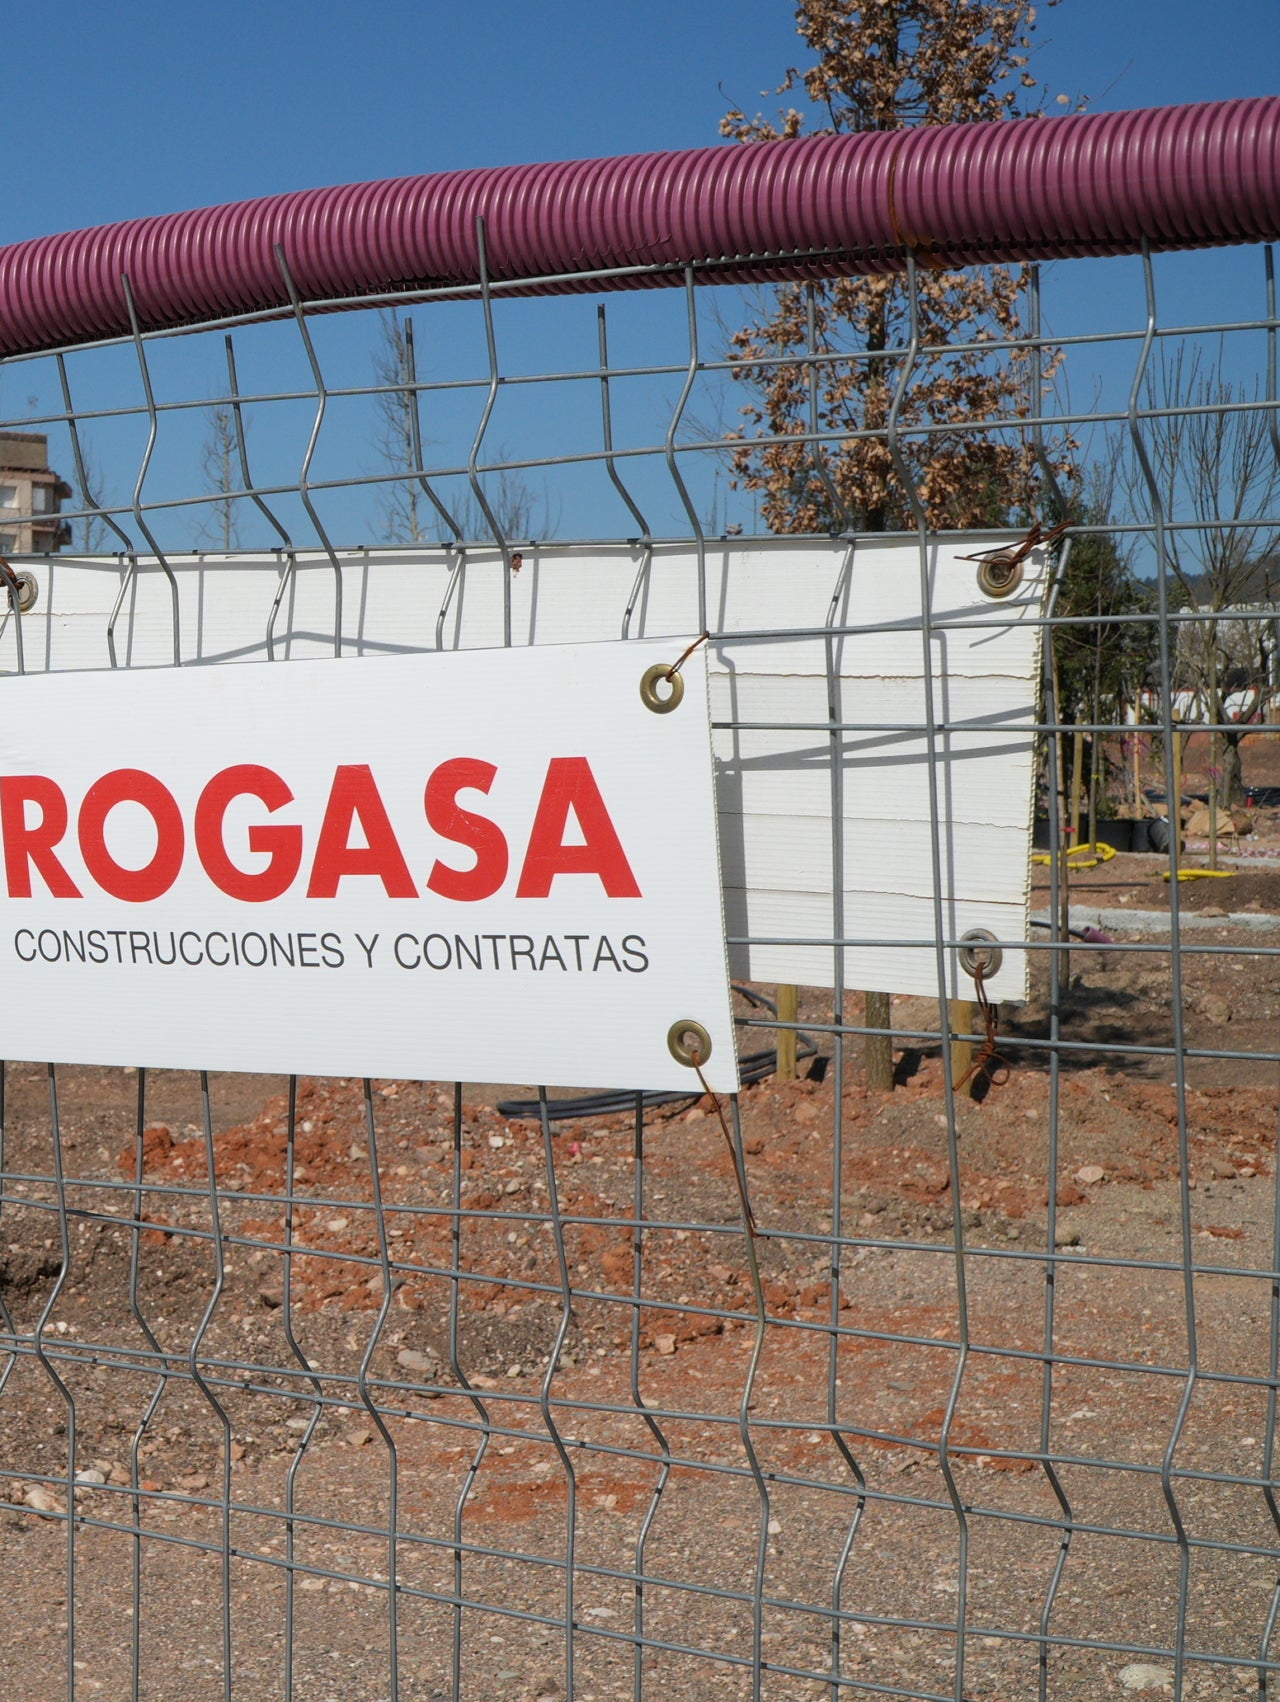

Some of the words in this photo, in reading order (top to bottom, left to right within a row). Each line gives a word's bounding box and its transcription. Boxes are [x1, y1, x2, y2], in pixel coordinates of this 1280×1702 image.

[0, 756, 643, 903] ROGASA
[14, 928, 345, 969] CONSTRUCCIONES
[354, 933, 380, 968] Y
[393, 933, 650, 973] CONTRATAS
